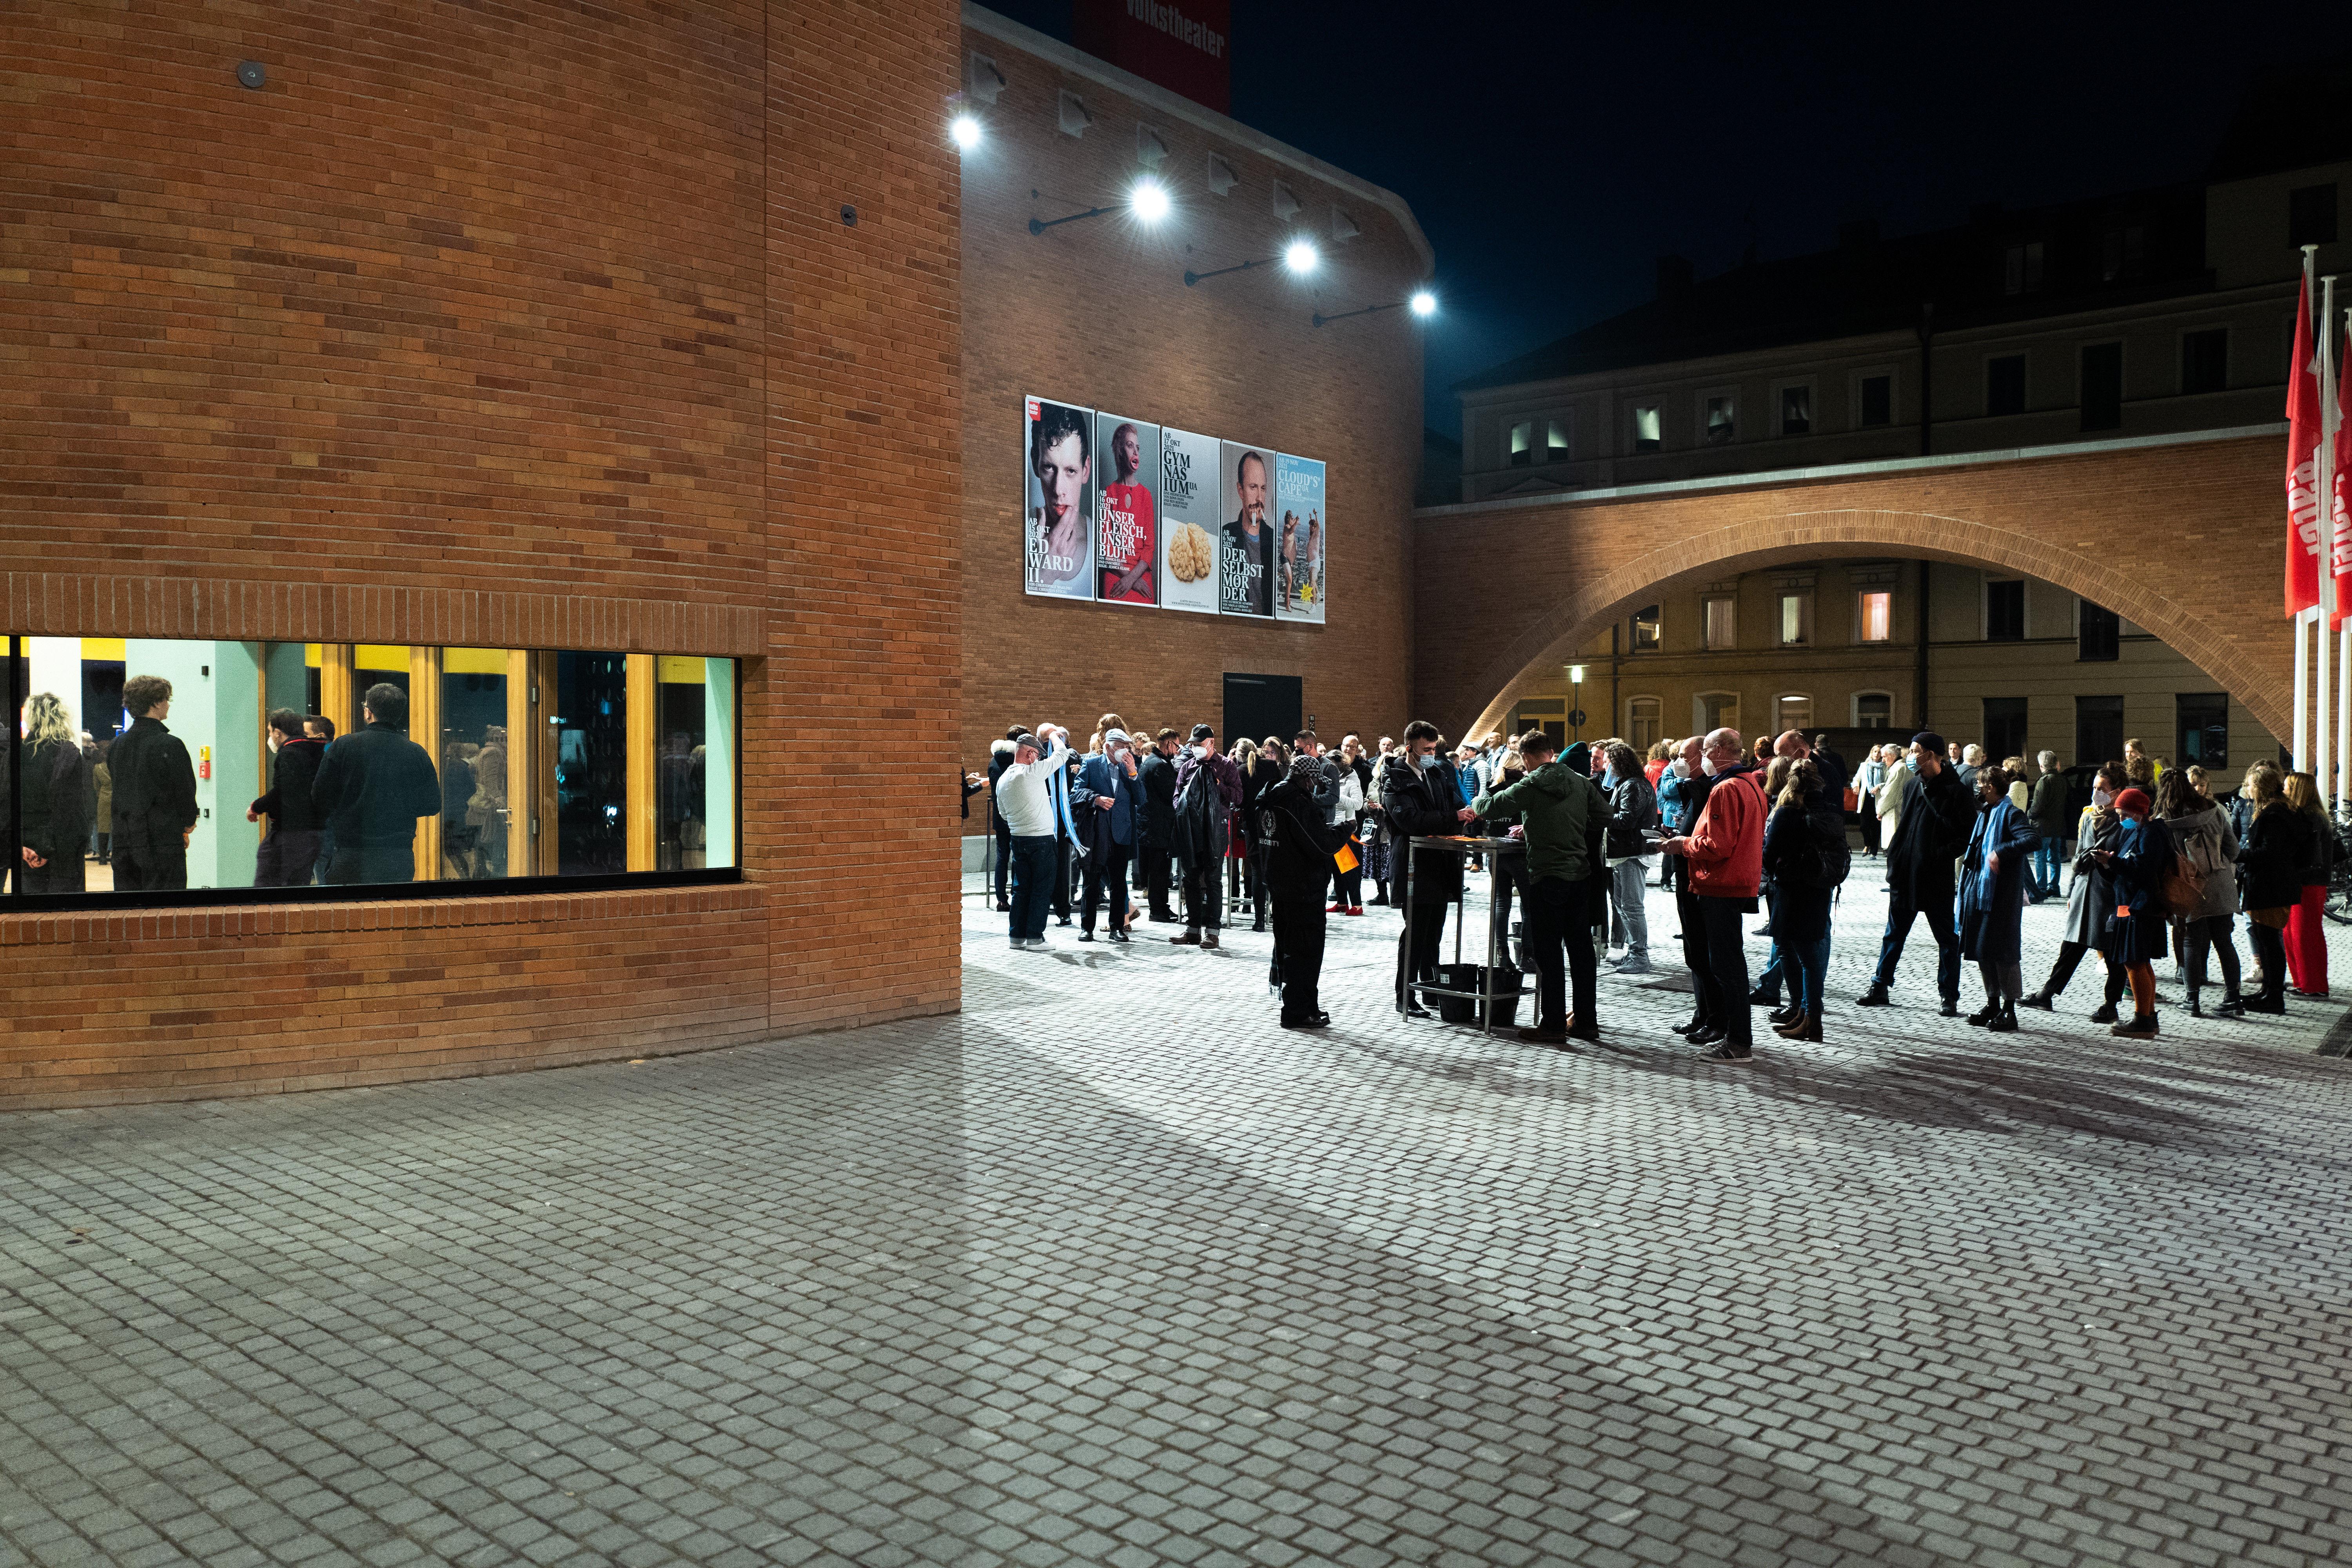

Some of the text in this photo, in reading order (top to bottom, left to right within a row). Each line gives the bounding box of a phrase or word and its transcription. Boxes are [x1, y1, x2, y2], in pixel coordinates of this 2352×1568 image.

[1164, 450, 1191, 468] GYM
[1164, 464, 1187, 481] NAS
[1278, 481, 1301, 496] CAPE
[1099, 508, 1135, 525] UNSER
[1099, 520, 1147, 540] FLEISCH,
[1029, 537, 1049, 554] ED
[1099, 532, 1135, 549] UNSER
[1099, 544, 1127, 559] BLUT
[1223, 546, 1247, 563] DER
[1029, 552, 1073, 572] WARD
[1223, 560, 1263, 578] SELBST
[1028, 567, 1044, 583] II.
[1223, 573, 1249, 588] MÖR
[1223, 586, 1247, 601] DER
[1259, 838, 1279, 846] SECURITY
